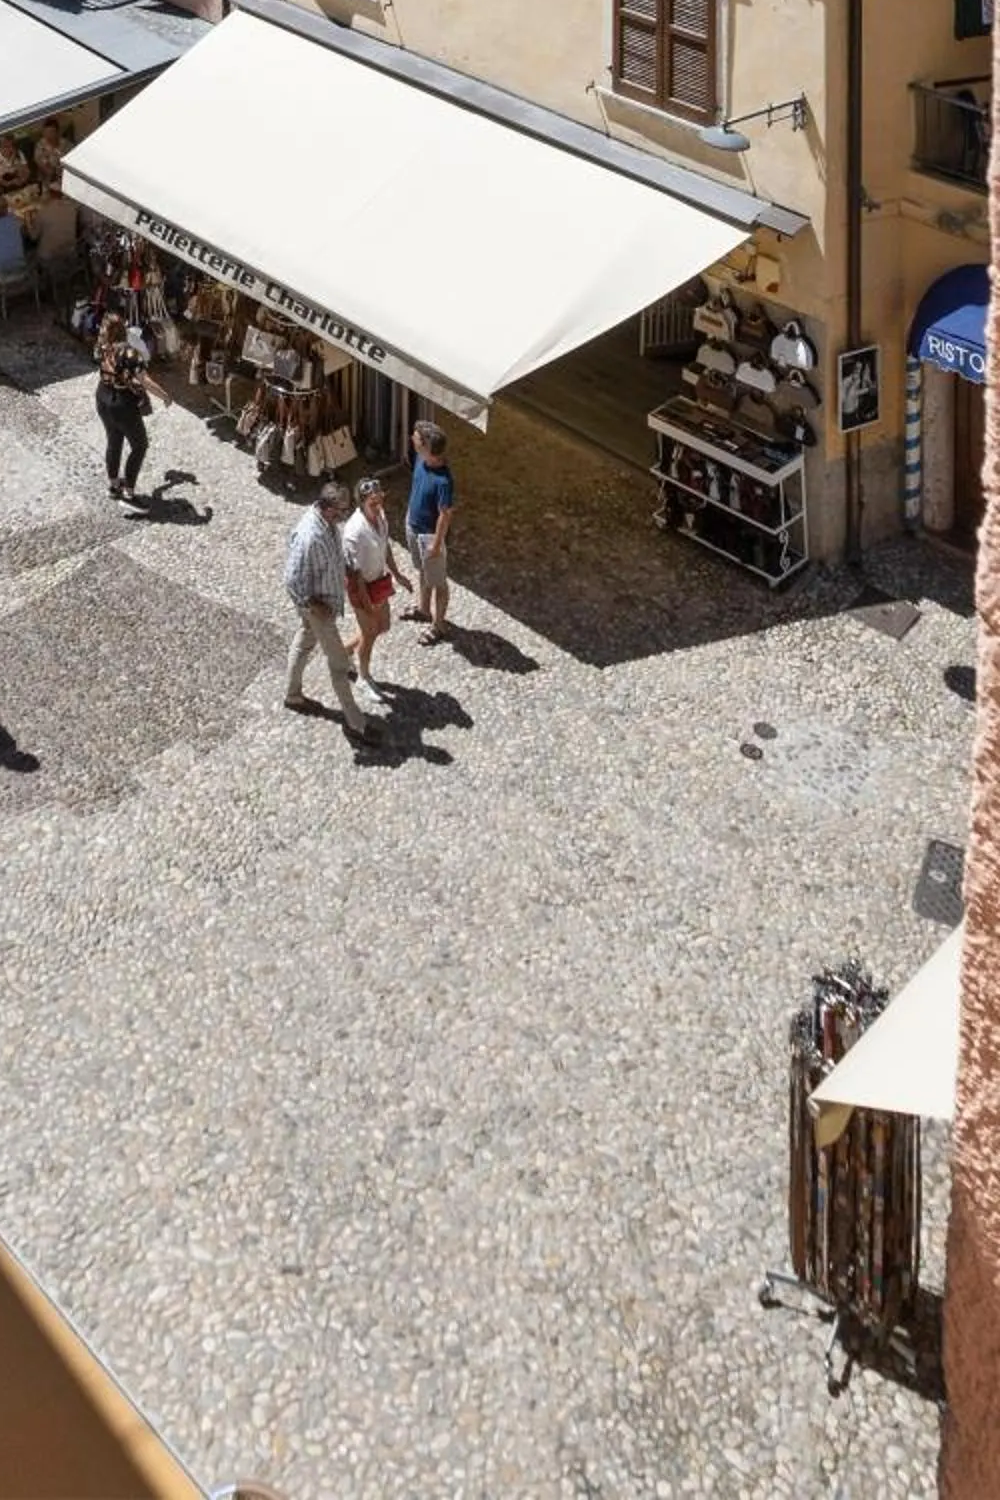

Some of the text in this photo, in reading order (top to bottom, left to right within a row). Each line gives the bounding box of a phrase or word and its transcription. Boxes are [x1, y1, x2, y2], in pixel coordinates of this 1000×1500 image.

[135, 211, 386, 364] Pelletterie Charlotte
[928, 335, 984, 373] RISTO
